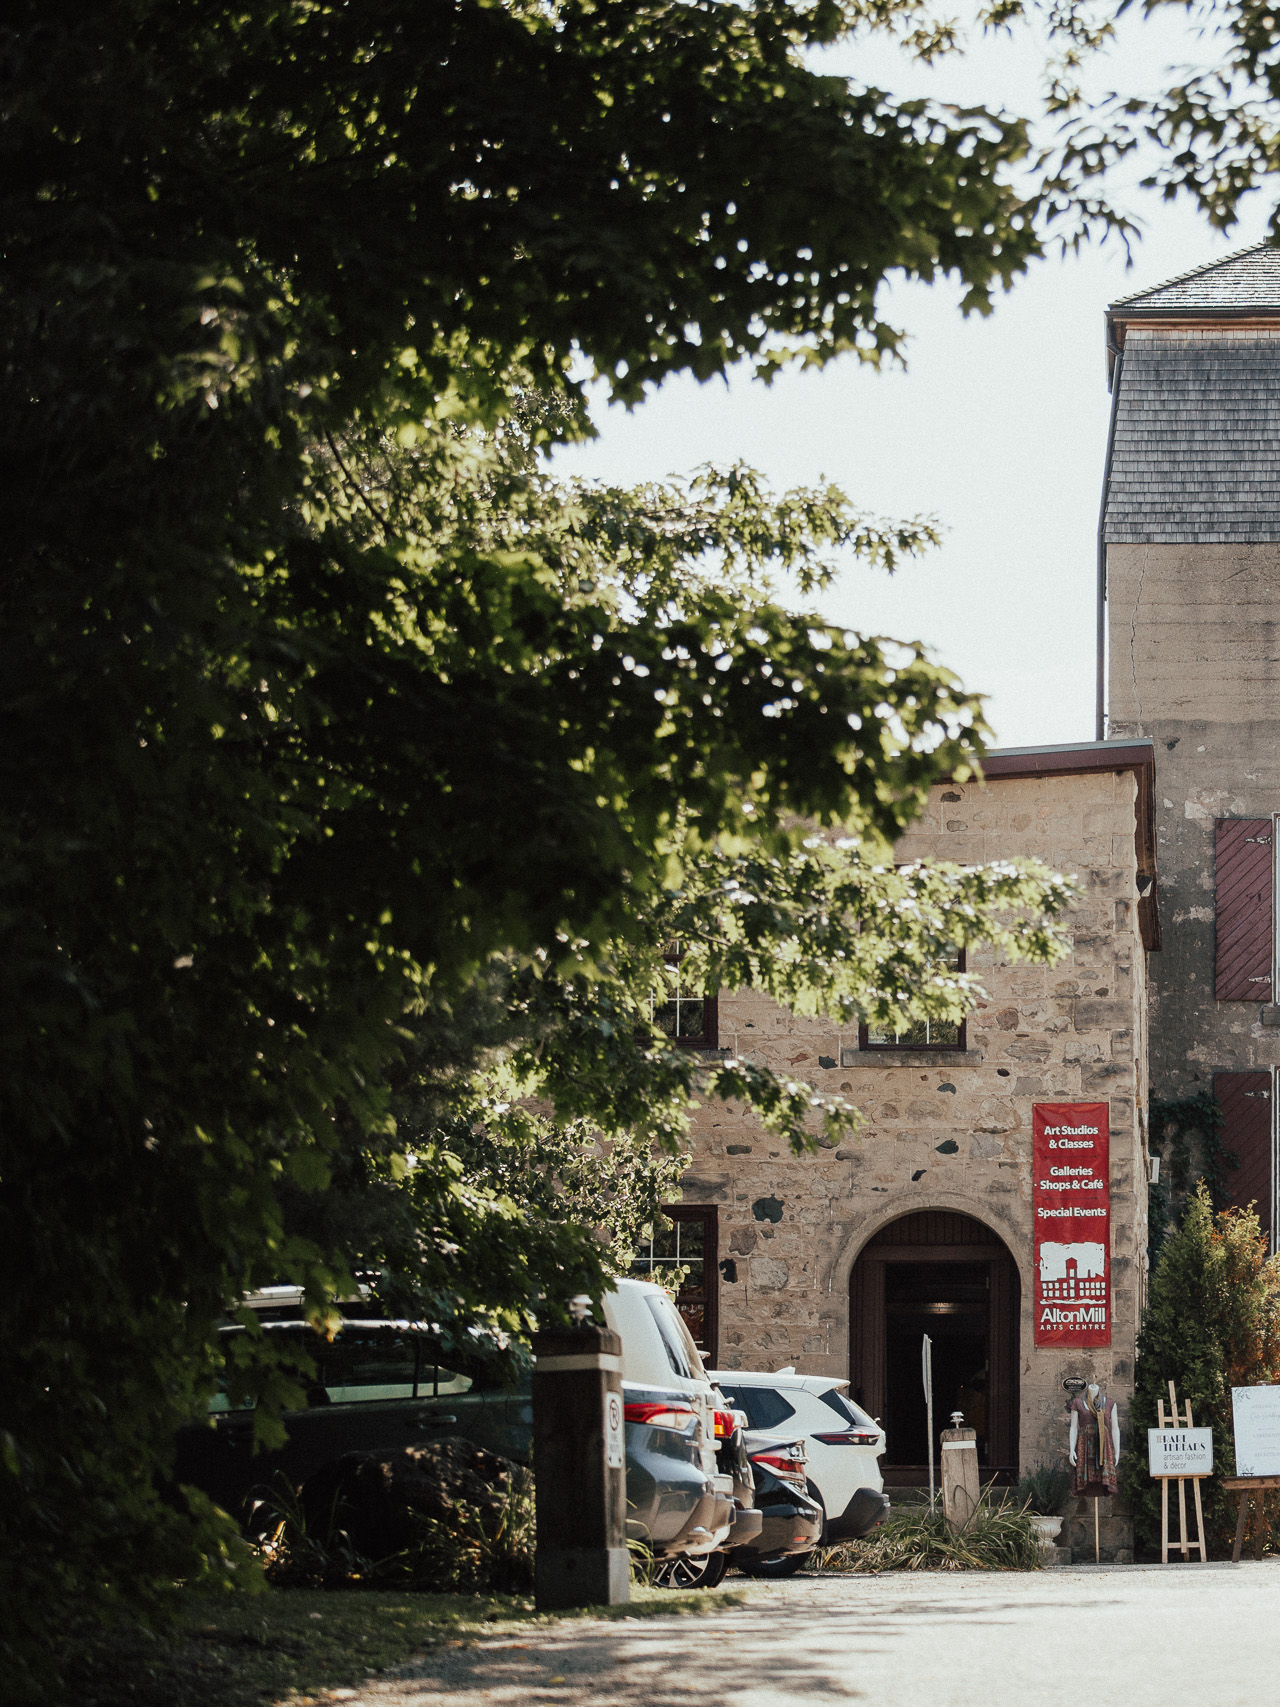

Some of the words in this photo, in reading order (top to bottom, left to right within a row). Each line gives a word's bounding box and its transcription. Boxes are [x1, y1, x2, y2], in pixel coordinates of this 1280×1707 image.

[1044, 1125, 1060, 1135] Art
[1061, 1125, 1098, 1135] Studios
[1049, 1139, 1057, 1149] &
[1058, 1139, 1094, 1149] Classes
[1050, 1166, 1093, 1176] Galleries
[1040, 1181, 1071, 1191] Shops
[1071, 1181, 1080, 1190] &
[1081, 1179, 1104, 1190] Café
[1038, 1207, 1073, 1219] Special
[1074, 1207, 1107, 1217] Events
[1040, 1308, 1106, 1323] AltonMill
[1163, 1434, 1187, 1443] RARE
[1164, 1443, 1206, 1452] THREADS
[1163, 1453, 1183, 1461] artisan
[1184, 1452, 1207, 1461] fashion
